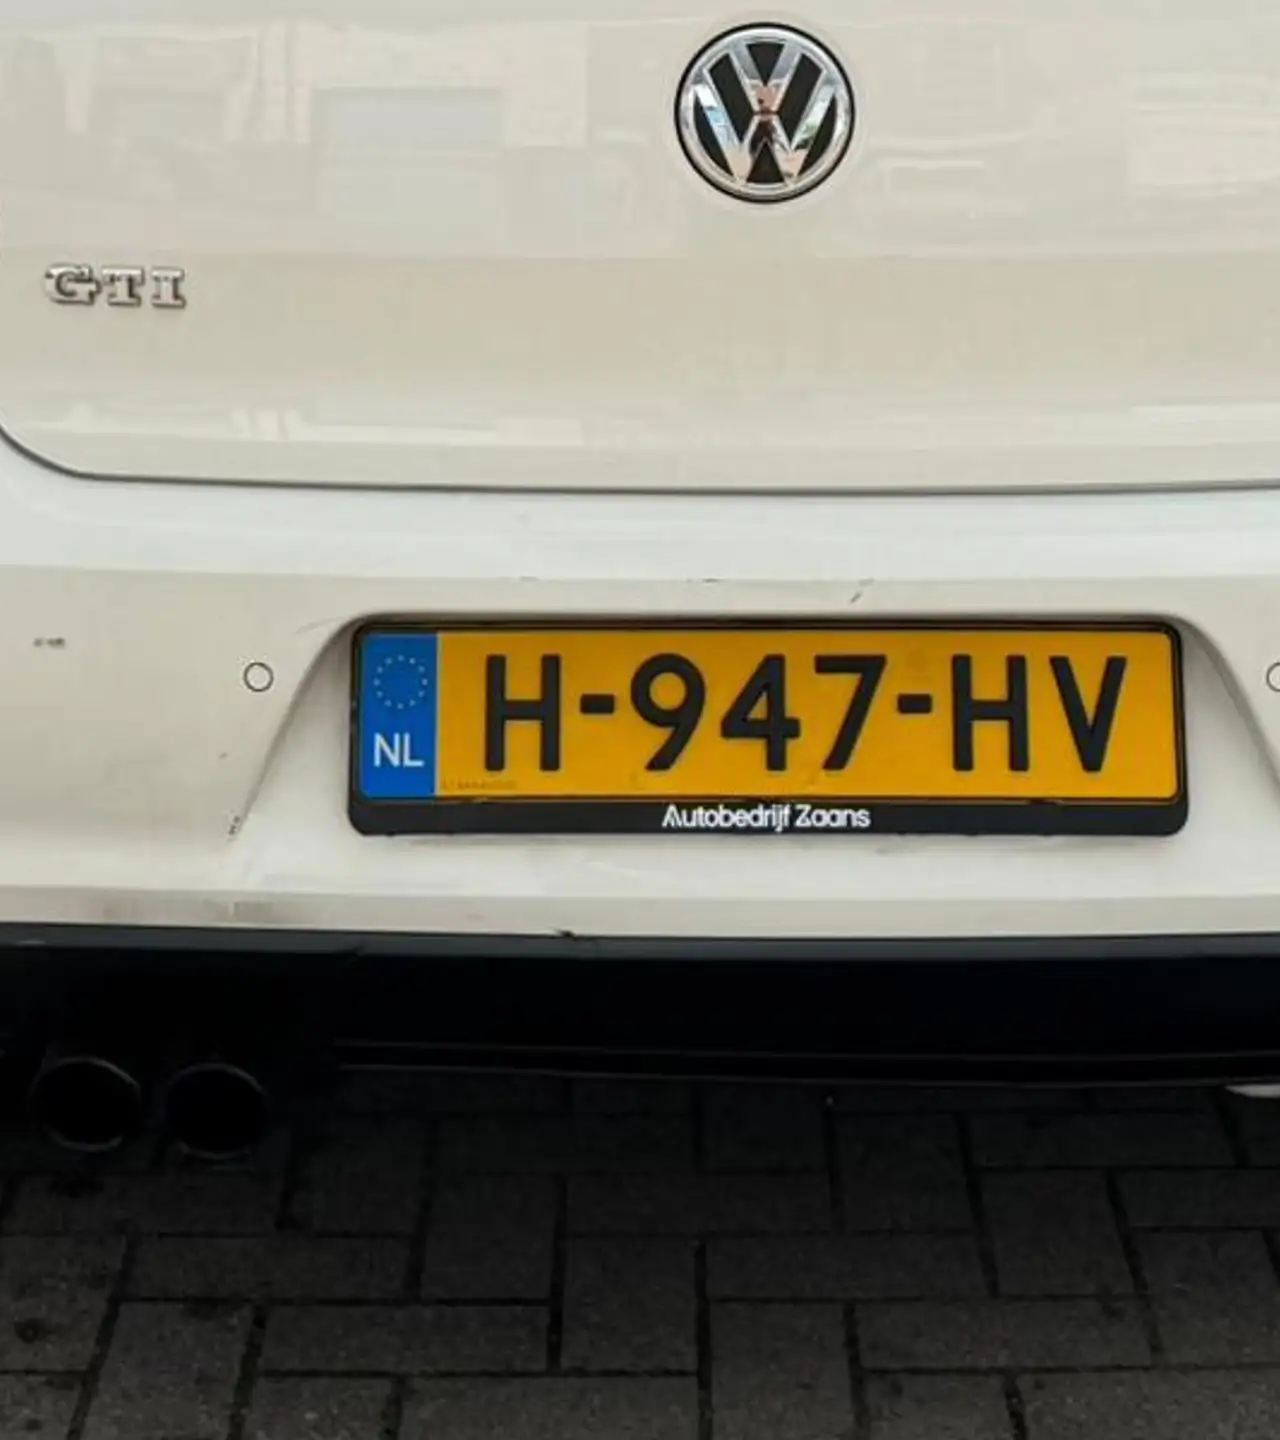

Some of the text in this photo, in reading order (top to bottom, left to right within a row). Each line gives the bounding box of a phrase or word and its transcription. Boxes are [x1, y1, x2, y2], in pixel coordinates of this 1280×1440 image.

[690, 37, 839, 190] VW
[44, 262, 187, 308] GTI
[483, 654, 1126, 774] H-947-HV
[374, 732, 425, 767] NL
[662, 804, 871, 832] Autobedrijf Zaans
